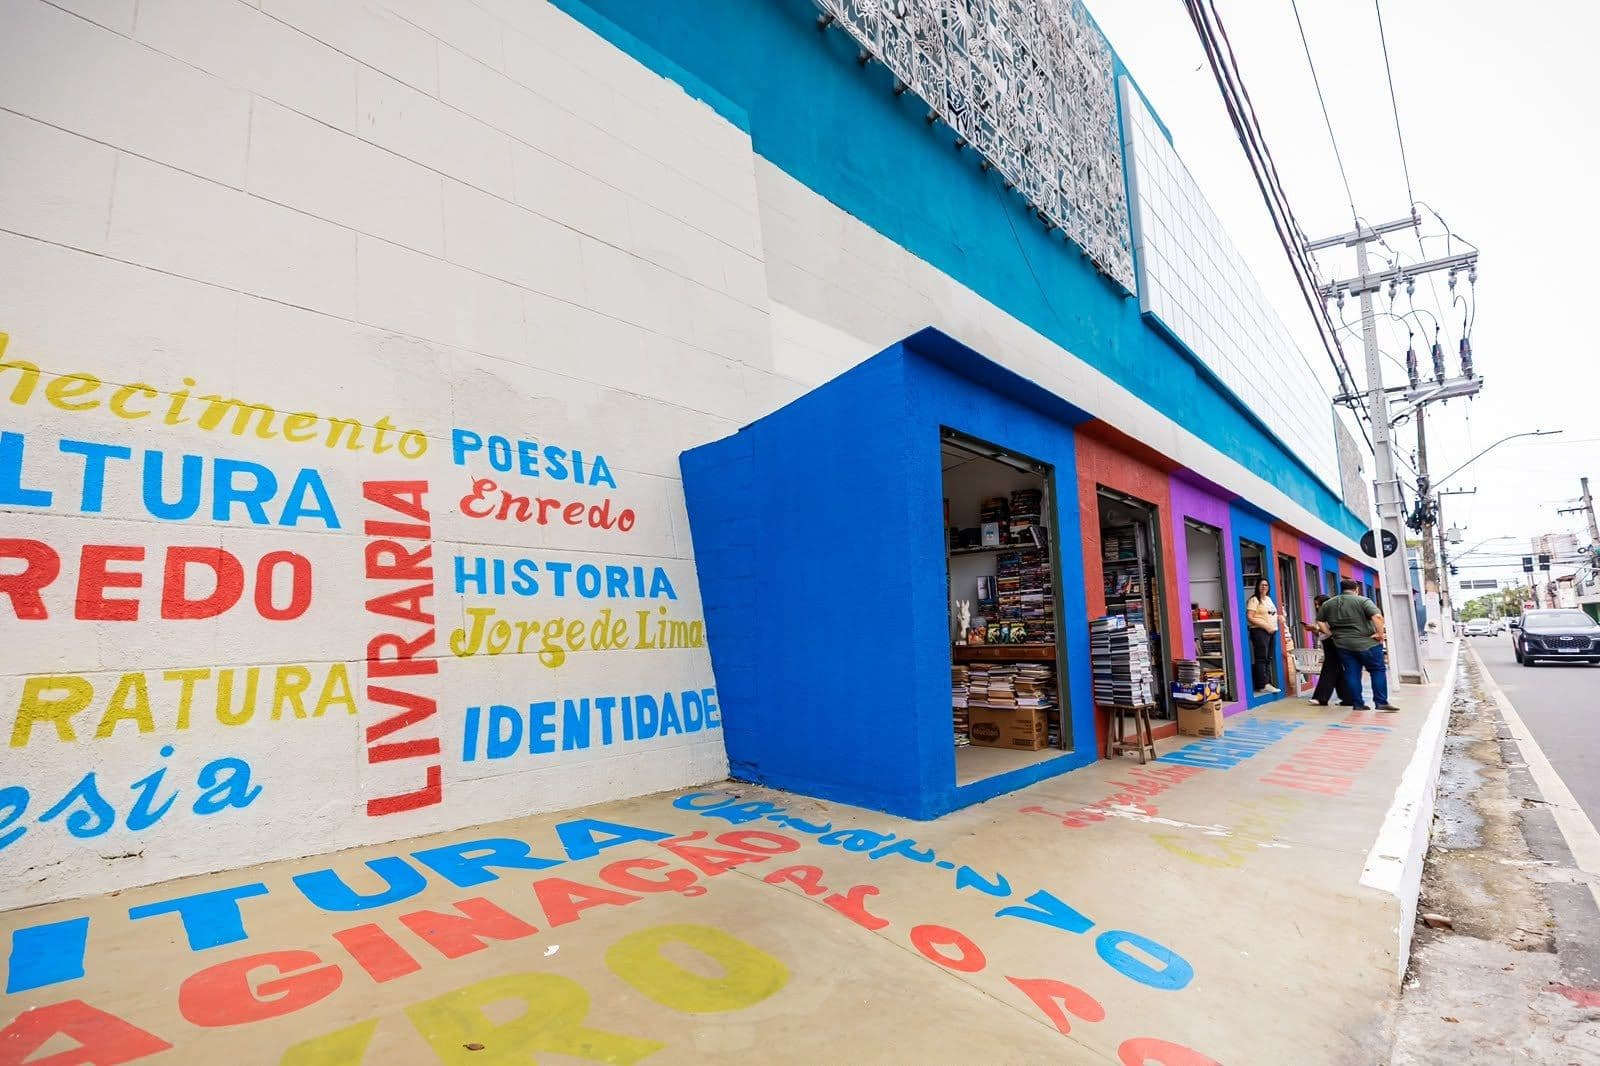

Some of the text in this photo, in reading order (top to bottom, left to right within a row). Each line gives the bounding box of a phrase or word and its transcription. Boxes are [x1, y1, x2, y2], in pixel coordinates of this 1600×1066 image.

[0, 332, 429, 460] hecimento
[452, 428, 617, 488] POESIA
[459, 476, 635, 532] Enredo
[454, 556, 678, 600] HISTORIA
[363, 480, 442, 817] LIVRARIA
[450, 605, 704, 668] Jorge de Lima
[463, 688, 721, 761] IDENTIDADE
